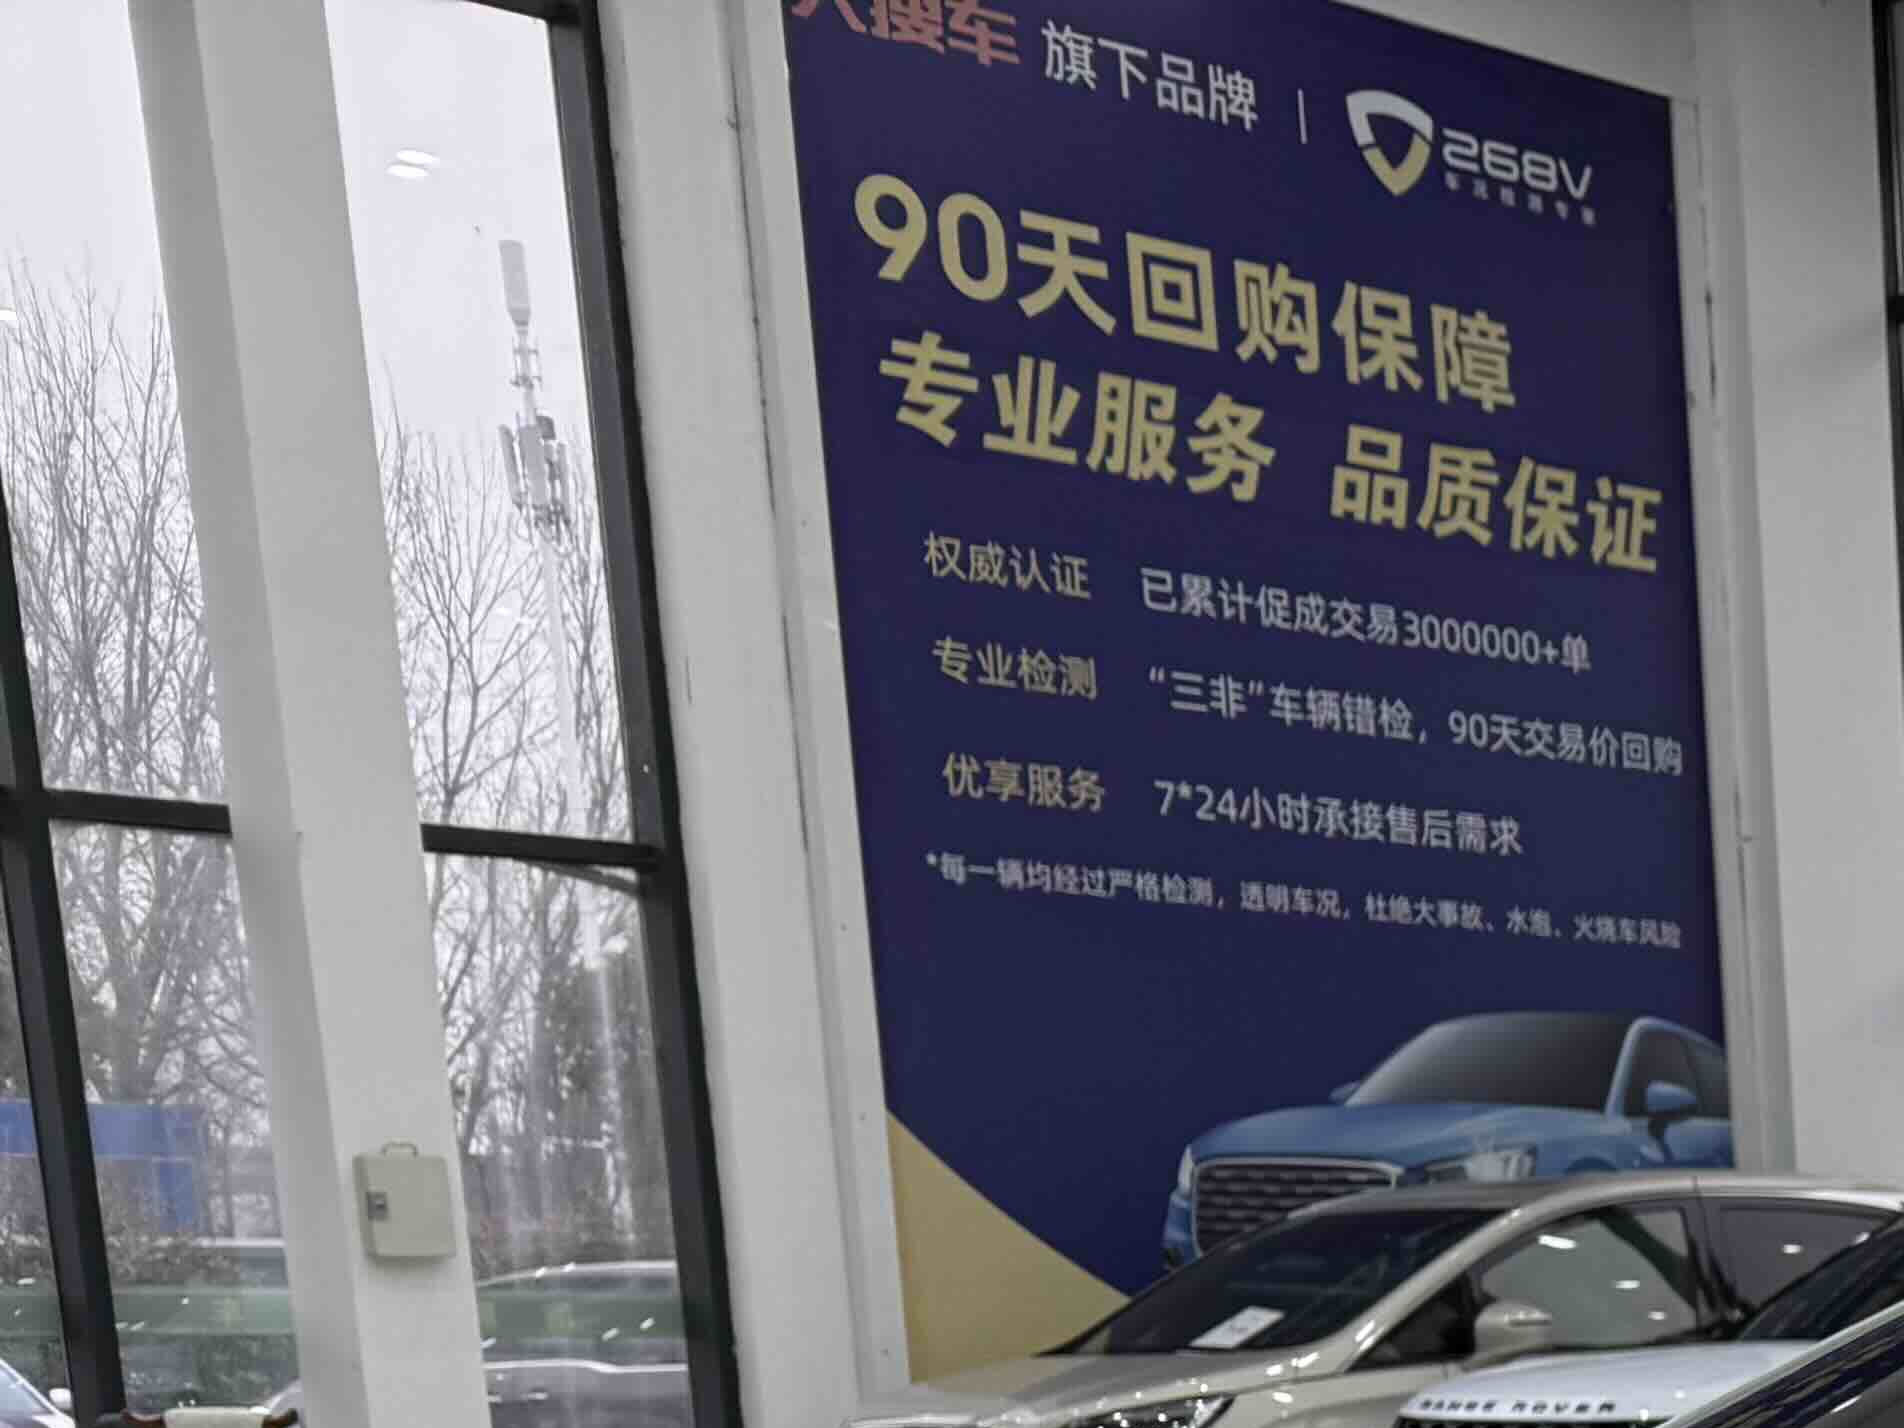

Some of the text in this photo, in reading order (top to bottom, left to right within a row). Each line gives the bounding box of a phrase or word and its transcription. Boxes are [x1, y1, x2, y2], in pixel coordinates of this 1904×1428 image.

[1041, 19, 1258, 132] 旗下品牌
[1442, 127, 1592, 198] 268V
[854, 174, 1516, 413] 90天回购保障
[880, 330, 1662, 573] 专业服务 品质保证
[924, 531, 1092, 600] 权威认证
[932, 635, 1097, 700] 专业检测
[943, 751, 1105, 812] 优享服务
